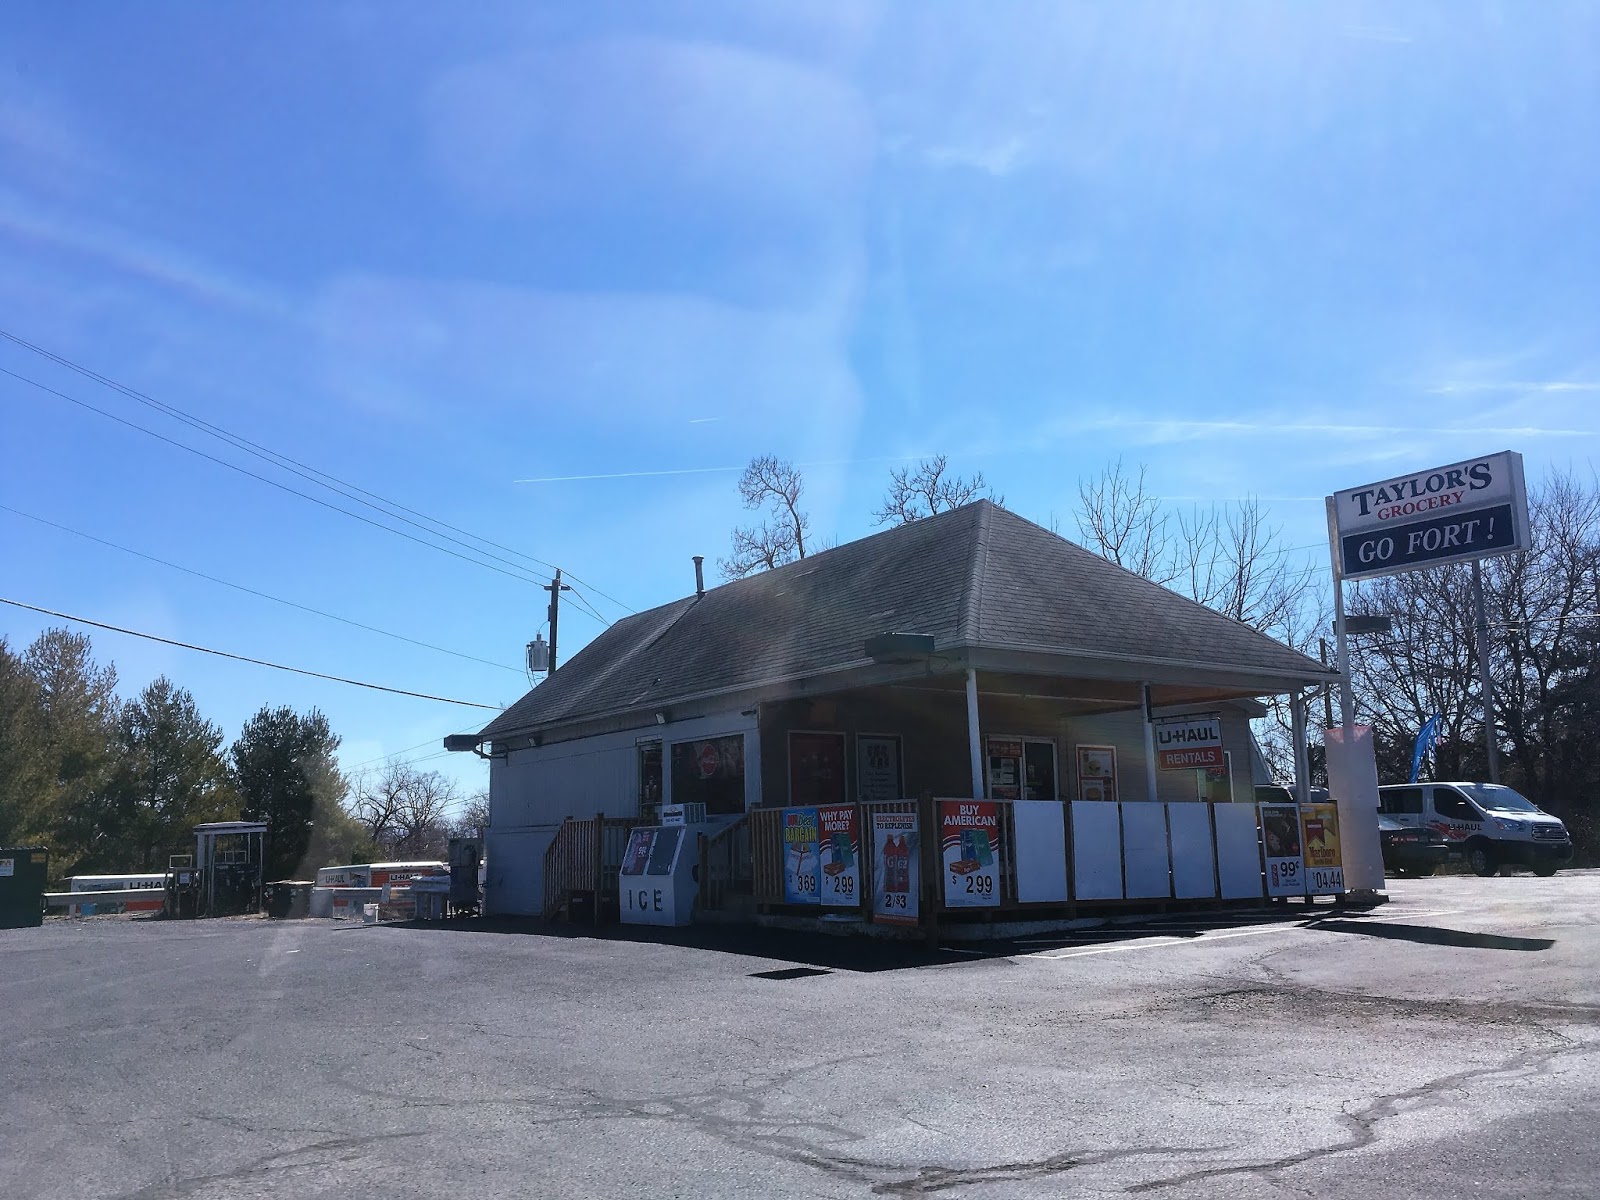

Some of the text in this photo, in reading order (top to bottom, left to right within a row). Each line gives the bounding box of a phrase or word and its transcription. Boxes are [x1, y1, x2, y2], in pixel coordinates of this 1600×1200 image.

[1352, 462, 1493, 517] TAYLOR'S
[1377, 490, 1465, 521] GROCERY
[1358, 537, 1395, 563] GO
[1406, 519, 1480, 555] FORT
[1158, 726, 1219, 745] U-HAUL
[1166, 751, 1216, 765] RENTALS
[820, 809, 853, 822] WHY PAY
[959, 804, 980, 815] BUY
[824, 820, 850, 832] MORE?
[943, 815, 996, 826] AMERICAN
[1448, 823, 1482, 831] U-HAUL
[785, 827, 817, 843] BARGAIN
[129, 881, 167, 890] U-HA
[628, 889, 663, 911] ICE
